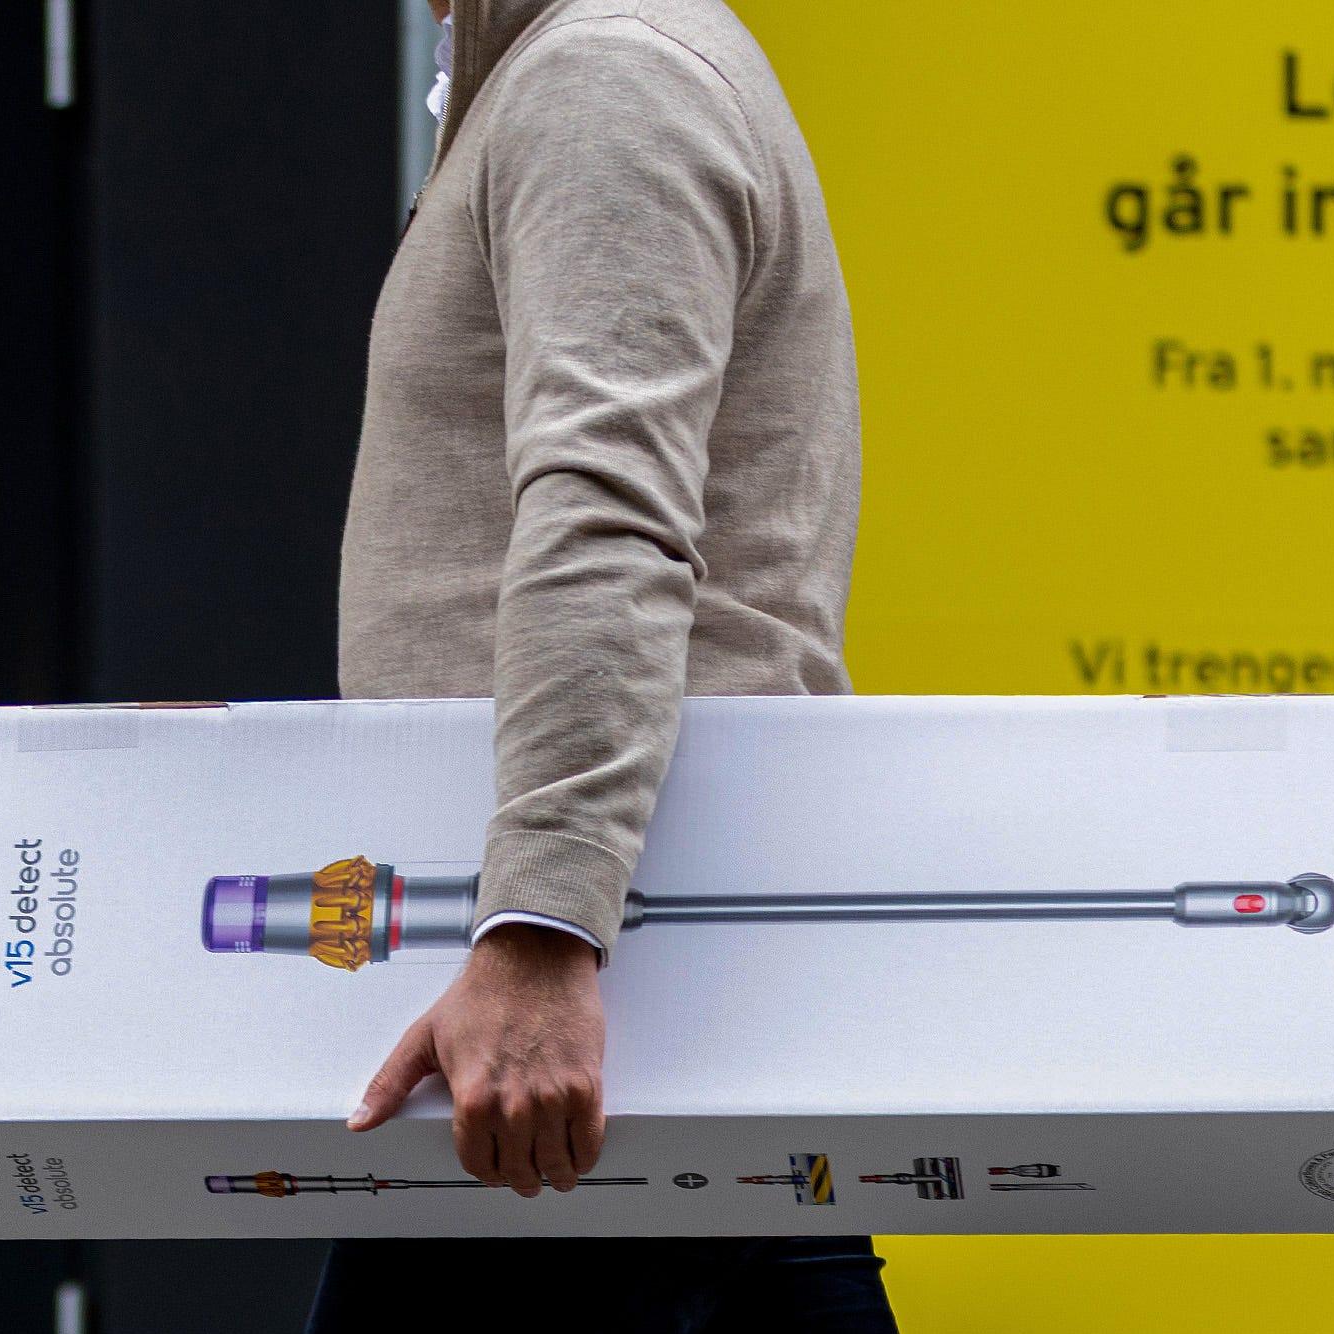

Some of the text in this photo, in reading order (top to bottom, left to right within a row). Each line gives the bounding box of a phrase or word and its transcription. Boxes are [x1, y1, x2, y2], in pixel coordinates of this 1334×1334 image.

[1102, 153, 1251, 255] går
[1149, 337, 1240, 393] Fra
[1255, 341, 1293, 391] 1.
[1069, 638, 1127, 690] Vi
[4, 838, 43, 989] v15 detect
[42, 847, 80, 977] absolute
[6, 1152, 49, 1215] v15 detect
[43, 1157, 78, 1210] absolute
